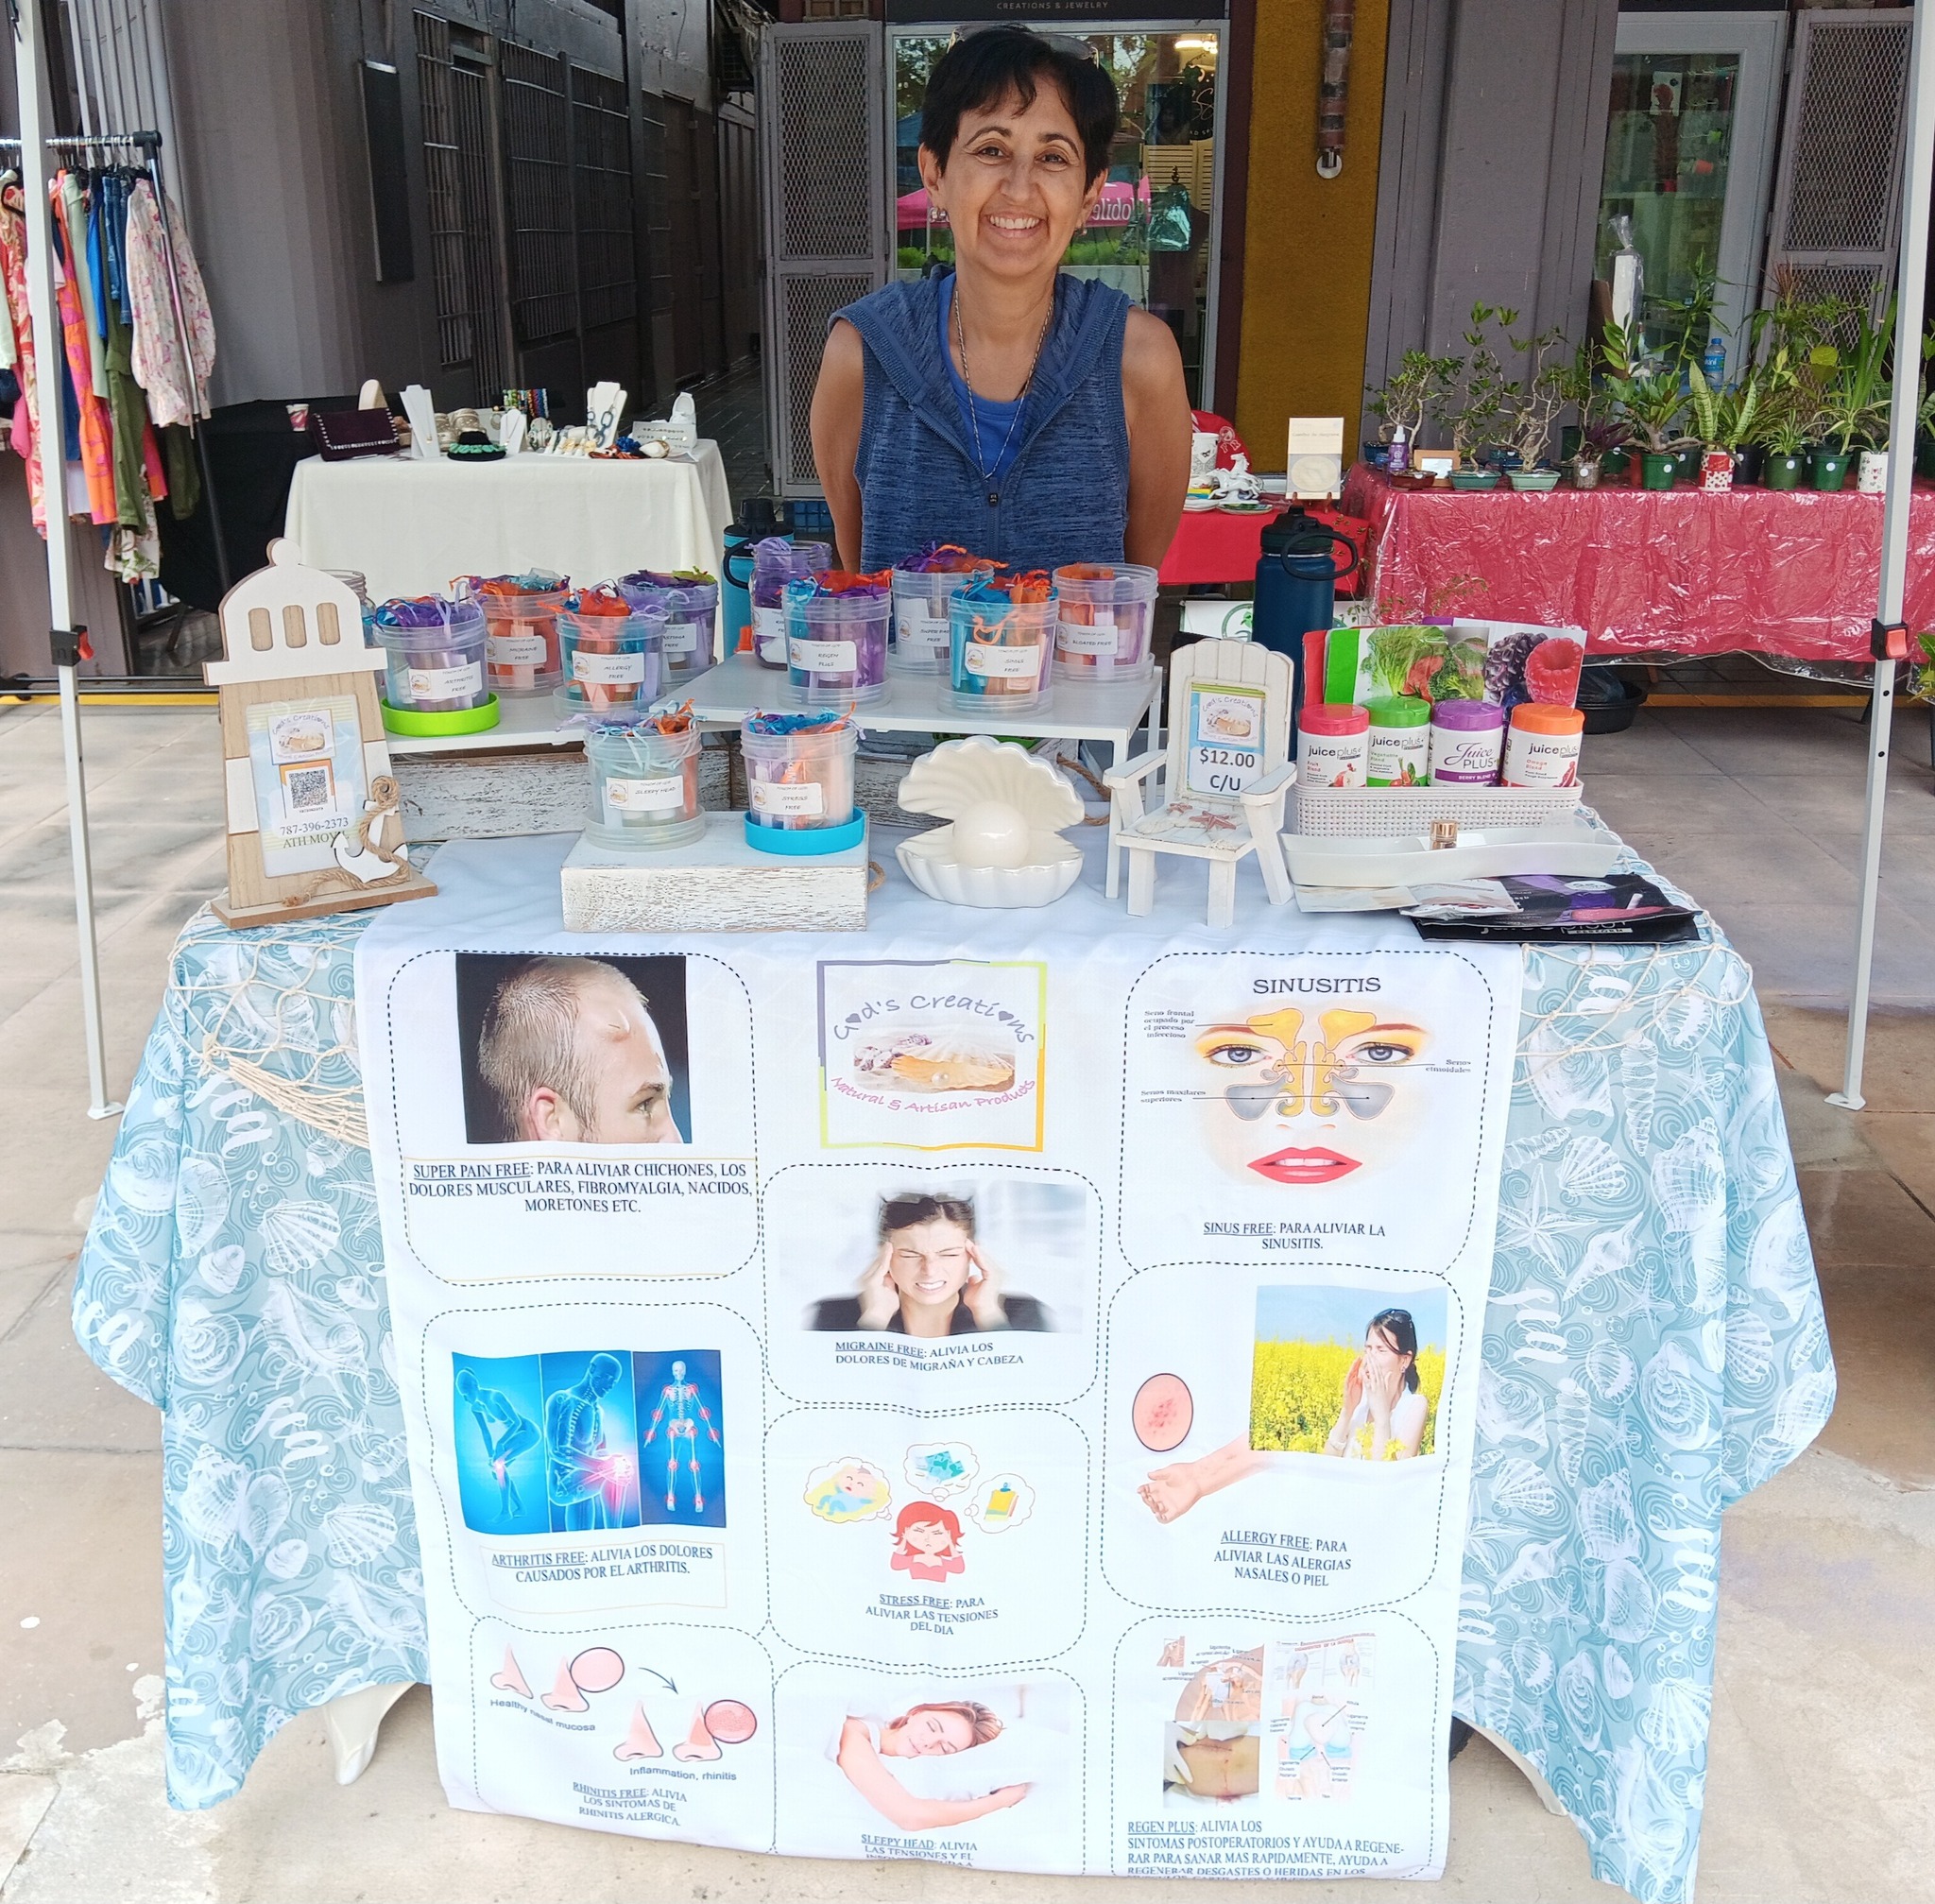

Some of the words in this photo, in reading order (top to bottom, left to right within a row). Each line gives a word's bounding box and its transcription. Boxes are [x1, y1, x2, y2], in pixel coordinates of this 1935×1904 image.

[1065, 1, 1108, 9] JEWELRY
[1371, 735, 1400, 747] juice
[1528, 743, 1559, 755] juice
[1200, 746, 1255, 768] $12.00
[1308, 745, 1336, 757] juice
[1444, 742, 1493, 766] Juice
[1209, 774, 1241, 792] C/U
[280, 816, 349, 836] 787-396-2373
[283, 835, 307, 849] ATH
[1253, 976, 1381, 994] SINUSITIS
[831, 1076, 884, 1106] Natural
[904, 1100, 972, 1113] Artisan
[974, 1080, 1036, 1106] Products
[414, 1164, 457, 1179] SUPER
[460, 1164, 491, 1177] PAIN
[495, 1162, 534, 1177] FREE:
[538, 1161, 574, 1175] PARA
[575, 1162, 631, 1176] ALIVIAR
[634, 1163, 718, 1178] CHICHONES,
[721, 1163, 746, 1176] LOS
[409, 1182, 473, 1197] DOLORES
[476, 1180, 575, 1196] MUSCULARES,
[578, 1181, 686, 1197] FIBROMYALGIA,
[688, 1181, 753, 1197] NACIDOS,
[525, 1198, 609, 1212] MORETONES
[612, 1199, 642, 1213] ETC.
[1203, 1222, 1241, 1235] SINUS
[1243, 1223, 1276, 1236] FREE:
[1279, 1222, 1312, 1234] PARA
[1313, 1223, 1366, 1236] ALIVIAR
[1369, 1225, 1386, 1237] LA
[1261, 1236, 1324, 1250] SINUSITIS.
[835, 1341, 894, 1352] MIGRAINE
[897, 1344, 927, 1358] FREE:
[930, 1345, 968, 1358] ALIVIA
[971, 1342, 994, 1352] LOS
[835, 1355, 890, 1364] DOLORES
[893, 1357, 907, 1368] DE
[910, 1359, 965, 1371] MIGRAÑA
[967, 1358, 975, 1367] Y
[977, 1355, 1024, 1366] CABEZA
[1220, 1530, 1277, 1545] ALLERGY
[1280, 1534, 1312, 1551] FREE:
[1316, 1538, 1347, 1552] PARA
[491, 1552, 553, 1567] ARTHRITIS
[556, 1551, 589, 1565] FREE:
[591, 1548, 632, 1562] ALIVIA
[634, 1544, 657, 1558] LOS
[659, 1544, 713, 1559] DOLORES
[1213, 1549, 1263, 1563] ALIVIAR
[1266, 1552, 1290, 1567] LAS
[1291, 1555, 1352, 1570] ALERGIAS
[515, 1568, 582, 1583] CAUSADOS
[584, 1565, 607, 1579] POR
[610, 1564, 625, 1577] EL
[626, 1560, 691, 1575] ARTHRITIS.
[1234, 1566, 1290, 1583] NASALES
[1291, 1572, 1301, 1585] O
[1303, 1573, 1329, 1587] PIEL
[879, 1593, 920, 1605] STRESS
[922, 1595, 953, 1609] FREE:
[955, 1597, 985, 1608] PARA
[865, 1605, 911, 1620] ALIVIAR
[914, 1609, 934, 1621] LAS
[937, 1609, 999, 1623] TENSIONES
[910, 1621, 933, 1632] DEL
[933, 1623, 954, 1636] DIA
[490, 1699, 528, 1713] Healthy
[529, 1708, 554, 1724] nasal
[556, 1721, 596, 1731] mucosa
[629, 1766, 699, 1781] Inflammation,
[702, 1771, 737, 1780] rhinitis
[573, 1781, 617, 1798] RHINITIS
[620, 1788, 650, 1799] FREE:
[651, 1788, 688, 1802] ALIVIA
[583, 1795, 603, 1807] LOS
[605, 1798, 661, 1809] SINTOMAS
[662, 1800, 676, 1812] DE
[578, 1806, 625, 1821] RHINITIS
[1127, 1821, 1165, 1833] REGEN
[1168, 1821, 1198, 1833] PLUS:
[1200, 1820, 1239, 1832] ALIVIA
[1241, 1820, 1262, 1833] LOS
[861, 1833, 901, 1847] SLEEPY
[939, 1841, 978, 1851] ALIVIA
[1127, 1837, 1185, 1849] SINTOMAS
[1188, 1836, 1291, 1849] POSTOPERATORIOS
[1293, 1836, 1301, 1848] Y
[1302, 1836, 1343, 1850] AYUDA
[1344, 1839, 1353, 1851] A
[1355, 1840, 1404, 1854] REGENE-
[865, 1844, 885, 1854] LAS
[889, 1847, 948, 1860] TENSIONES
[1127, 1853, 1151, 1863] RAR
[1154, 1853, 1182, 1864] PARA
[1184, 1853, 1223, 1864] SANAR
[1224, 1852, 1249, 1863] MAS
[1252, 1852, 1336, 1866] RAPIDAMENTE,
[1338, 1855, 1378, 1866] AYUDA
[1127, 1866, 1194, 1875] REGENERAR
[1196, 1867, 1260, 1876] DESGASTES
[1262, 1867, 1272, 1876] O
[1274, 1867, 1324, 1877] HERIDAS
[1327, 1868, 1342, 1877] EN
